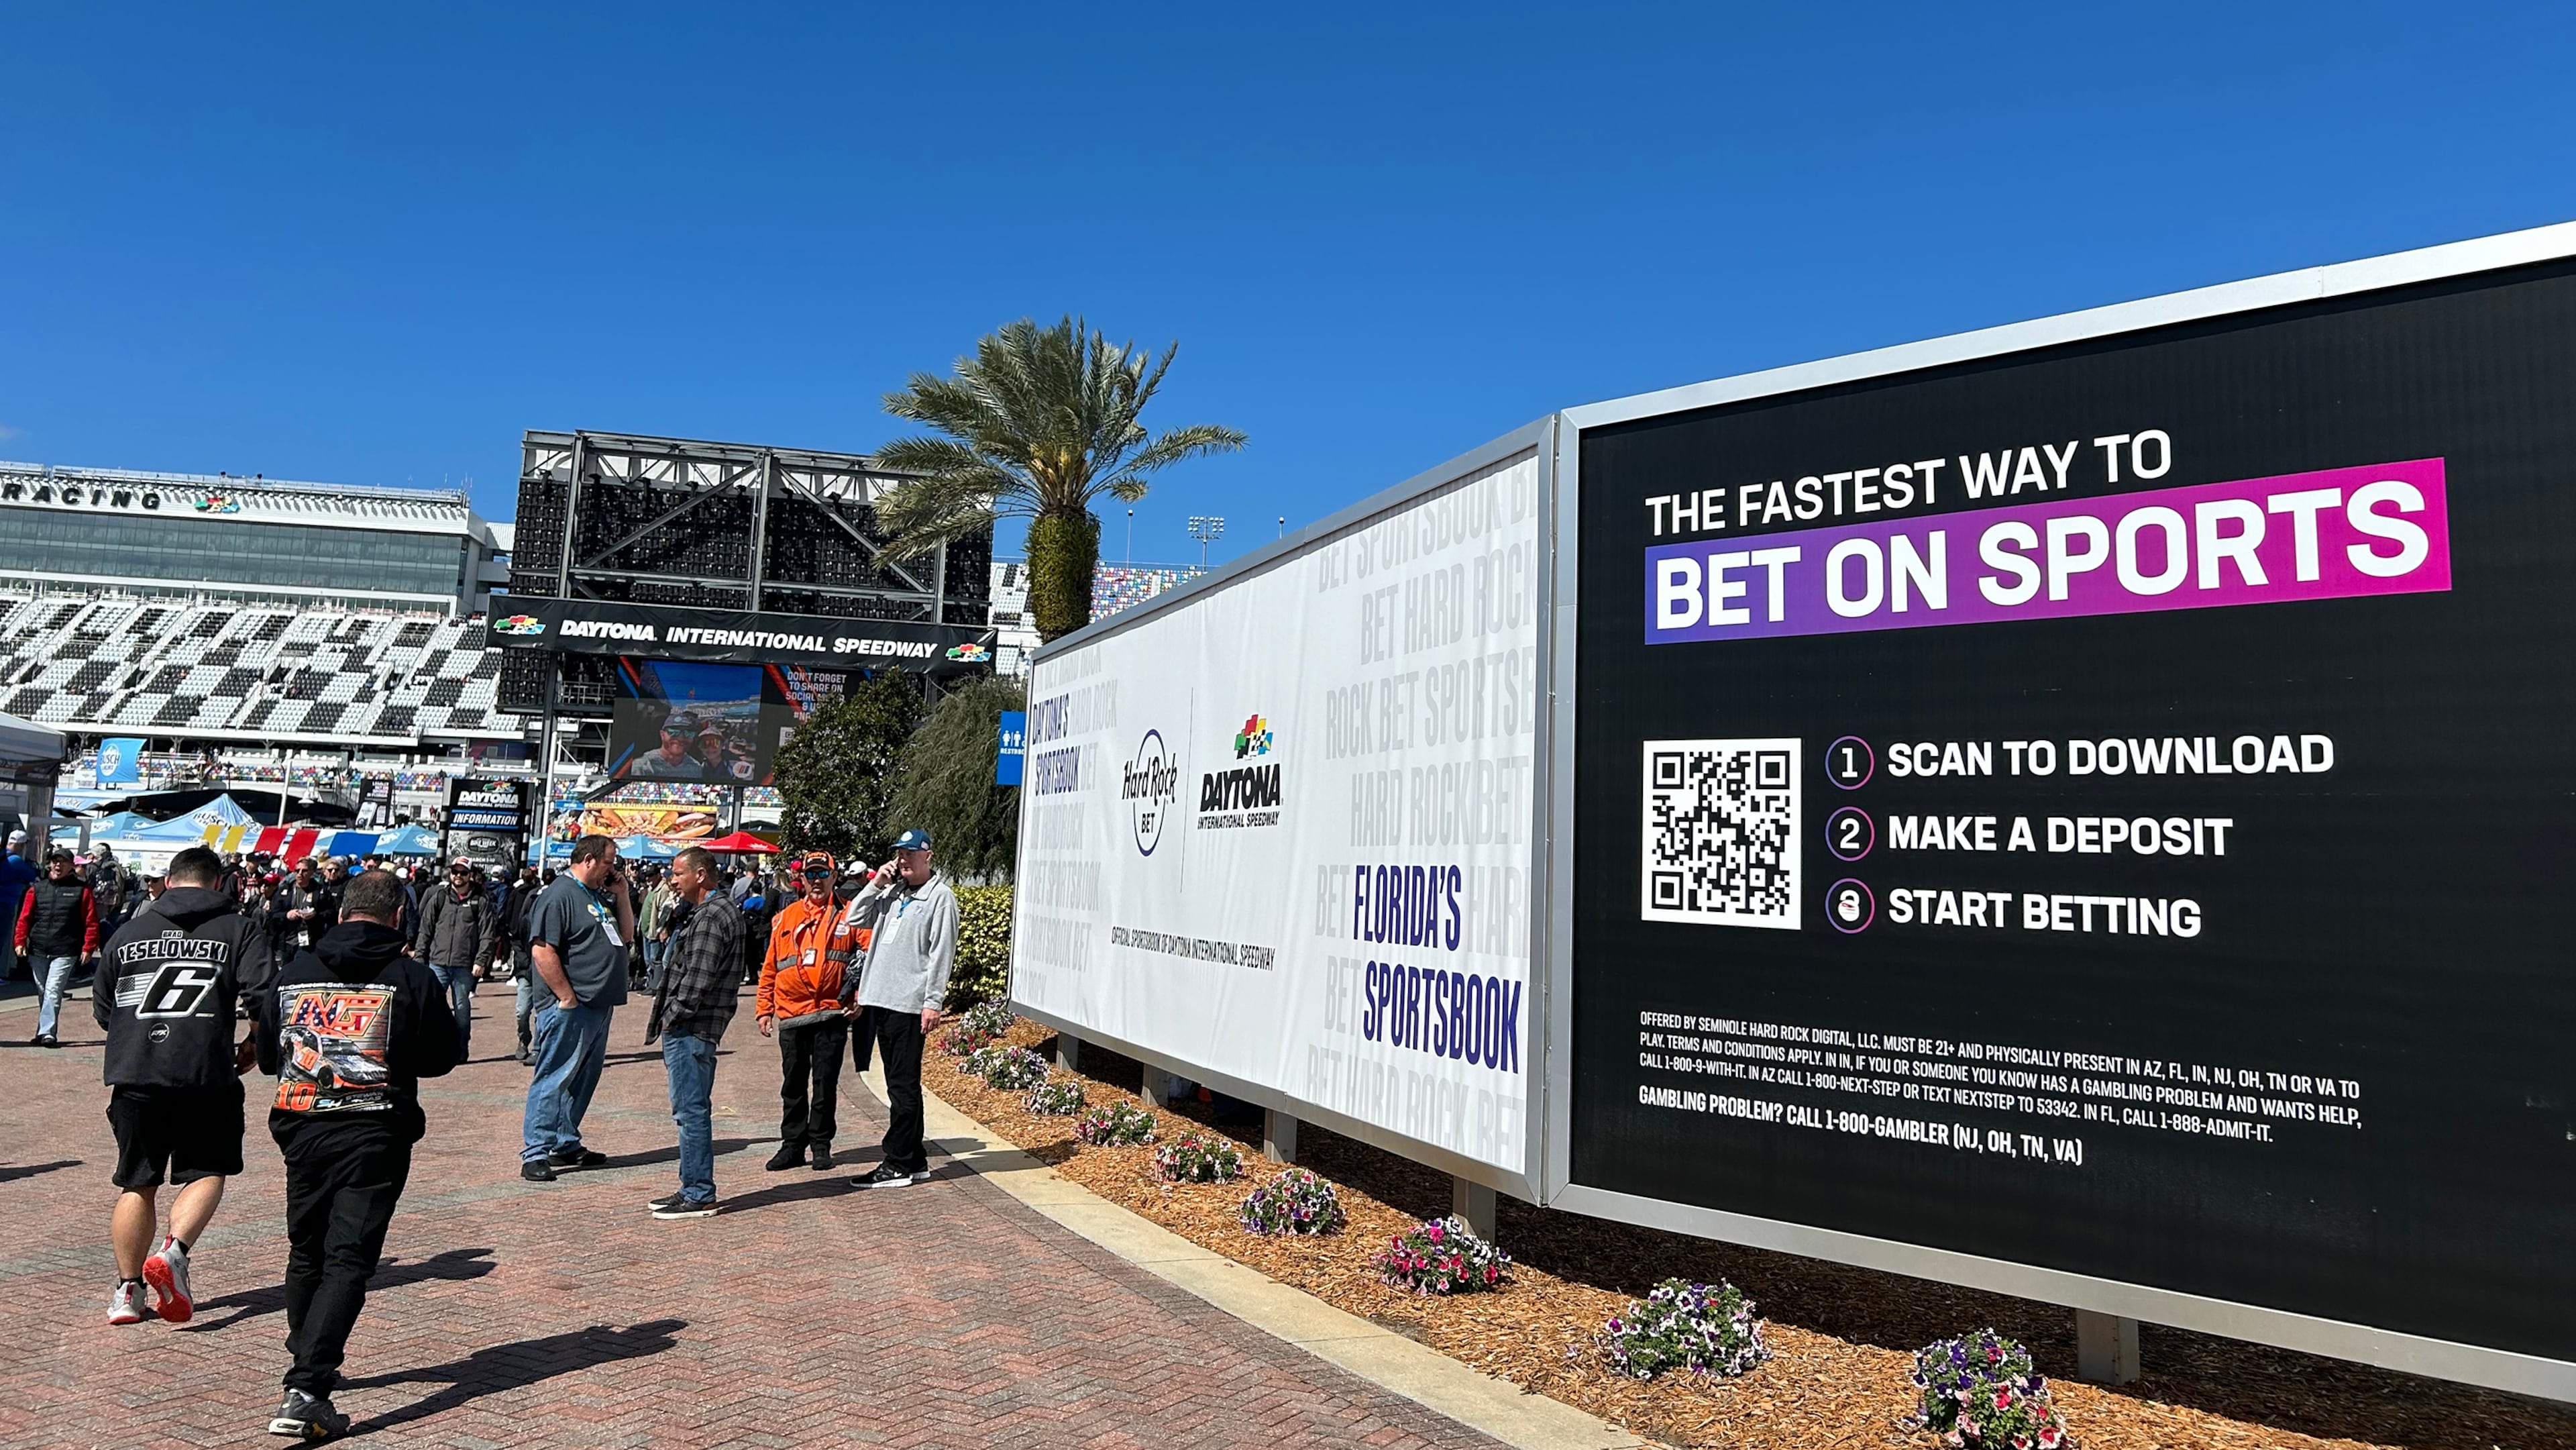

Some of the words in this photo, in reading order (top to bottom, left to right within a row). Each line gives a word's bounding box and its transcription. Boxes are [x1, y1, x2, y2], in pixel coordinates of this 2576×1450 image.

[1, 482, 161, 510] RACING
[1645, 488, 1725, 536] THE
[1739, 459, 1945, 527] FASTEST
[1959, 440, 2079, 499] WAY
[2094, 429, 2171, 482] TO
[1657, 546, 1801, 629] BET
[1826, 530, 1947, 617] ON
[1978, 480, 2429, 606] SPORTS
[559, 619, 655, 641] DAYTONA
[665, 627, 826, 652] INTERNATIONAL
[833, 637, 938, 658] SPEEDWAY
[1361, 583, 1399, 665] BET
[1404, 563, 1465, 655] HARD
[786, 692, 816, 701] SOCIAL
[789, 682, 800, 690] TO
[814, 672, 847, 683] FORGET
[1032, 693, 1069, 745] DAYTONA'S
[1093, 678, 1118, 731] ROCK
[1326, 680, 1373, 760] ROCK
[1379, 670, 1419, 752] BET
[1035, 745, 1080, 796] SPORTSBOOK
[1122, 757, 1151, 800] Hard
[1150, 752, 1177, 807] Rock
[1841, 747, 1858, 778] 1
[1888, 741, 1992, 777] SCAN
[2002, 739, 2056, 776] TO
[2068, 734, 2334, 776] DOWNLOAD
[459, 790, 519, 805] DAYTONA
[1199, 764, 1281, 812] DAYTONA
[1350, 769, 1403, 847] HARD
[1409, 761, 1471, 847] ROCK
[1475, 755, 1529, 845] BET
[453, 813, 518, 826] INFORMATION
[1141, 813, 1155, 833] BET
[1197, 814, 1244, 830] INTERNATIONAL
[1246, 811, 1280, 827] SPEEDWAY
[1839, 818, 1860, 849] 2
[1888, 815, 1997, 851] MAKE
[2007, 817, 2037, 852] A
[2047, 817, 2233, 856] DEPOSIT
[1315, 864, 1350, 939] BET
[1353, 864, 1462, 951] FLORIDA'S
[1888, 888, 2012, 928] START
[2023, 893, 2202, 938] BETTING
[1111, 926, 1130, 947] OFFICIAL
[1131, 929, 1161, 952] SPORTSBOOK
[1161, 933, 1169, 953] OF
[1168, 935, 1191, 958] DAYTONA
[1191, 938, 1238, 966] INTERNATIONAL
[1239, 944, 1276, 971] SPEEDWAY
[135, 961, 223, 1020] 6
[1324, 955, 1361, 1037] BET
[1363, 960, 1522, 1074] SPORTSBOOK
[1640, 1011, 1682, 1029] OFFERED
[1683, 1015, 1697, 1030] BY
[1698, 1017, 1748, 1036] SEMINOLE
[1749, 1022, 1778, 1039] HARD
[1780, 1025, 1810, 1043] ROCK
[1812, 1028, 1856, 1049] DIGITAL,
[1858, 1033, 1881, 1049] LLC.
[1884, 1035, 1917, 1053] MUST
[1918, 1038, 1933, 1055] BE
[1935, 1039, 1955, 1056] 21+
[1957, 1042, 1983, 1059] AND
[1986, 1045, 2061, 1068] PHYSICALLY
[2063, 1052, 2124, 1074] PRESENT
[2126, 1058, 2140, 1076] IN
[2143, 1059, 2165, 1081] AZ,
[2169, 1062, 2189, 1083] FL,
[2192, 1064, 2211, 1086] IN,
[2214, 1067, 2235, 1088] NJ,
[2239, 1070, 2264, 1092] OH,
[2266, 1072, 2287, 1091] TN
[2290, 1075, 2312, 1094] OR
[2315, 1077, 2337, 1096] VA
[2338, 1080, 2360, 1099] TO
[1640, 1031, 1664, 1047] PLAY.
[1666, 1034, 1700, 1051] TERMS
[1701, 1038, 1723, 1054] AND
[1724, 1040, 1786, 1061] CONDITIONS
[1787, 1047, 1823, 1066] APPLY.
[1825, 1051, 1837, 1068] IN
[1839, 1053, 1854, 1072] IN,
[1856, 1055, 1866, 1070] IF
[1868, 1056, 1891, 1074] YOU
[1893, 1058, 1910, 1076] OR
[1912, 1060, 1969, 1082] SOMEONE
[1971, 1066, 1996, 1085] YOU
[1999, 1070, 2038, 1089] KNOW
[2041, 1074, 2068, 1092] HAS
[2070, 1077, 2080, 1094] A
[2082, 1078, 2153, 1102] GAMBLING
[2155, 1086, 2223, 1110] PROBLEM
[2226, 1094, 2257, 1114] AND
[2260, 1098, 2316, 1121] WANTS
[2318, 1104, 2362, 1129] HELP,
[274, 1081, 317, 1111] 10
[1640, 1052, 1663, 1069] CALL
[1664, 1055, 1747, 1079] 1-800-9-WITH-IT.
[1748, 1065, 1760, 1080] IN
[1761, 1067, 1776, 1082] AZ
[1777, 1068, 1804, 1086] CALL
[1805, 1072, 1901, 1097] 1-800-NEXT-STEP
[1903, 1082, 1920, 1100] OR
[1921, 1085, 1951, 1103] TEXT
[1953, 1088, 2015, 1110] NEXTSTEP
[2017, 1095, 2034, 1113] TO
[2037, 1098, 2081, 1119] 53342.
[2084, 1103, 2098, 1121] IN
[2100, 1104, 2120, 1126] FL,
[2123, 1107, 2157, 1128] CALL
[2160, 1112, 2273, 1143] 1-888-ADMIT-IT.
[1639, 1085, 1707, 1112] GAMBLING
[1709, 1094, 1784, 1123] PROBLEM?
[1786, 1104, 1823, 1129] CALL
[1825, 1109, 1949, 1145] 1-800-GAMBLER
[1953, 1123, 1984, 1153] (NJ,
[1988, 1130, 2017, 1158] OH,
[2020, 1134, 2049, 1163] TN,
[2053, 1138, 2082, 1166] VA)
